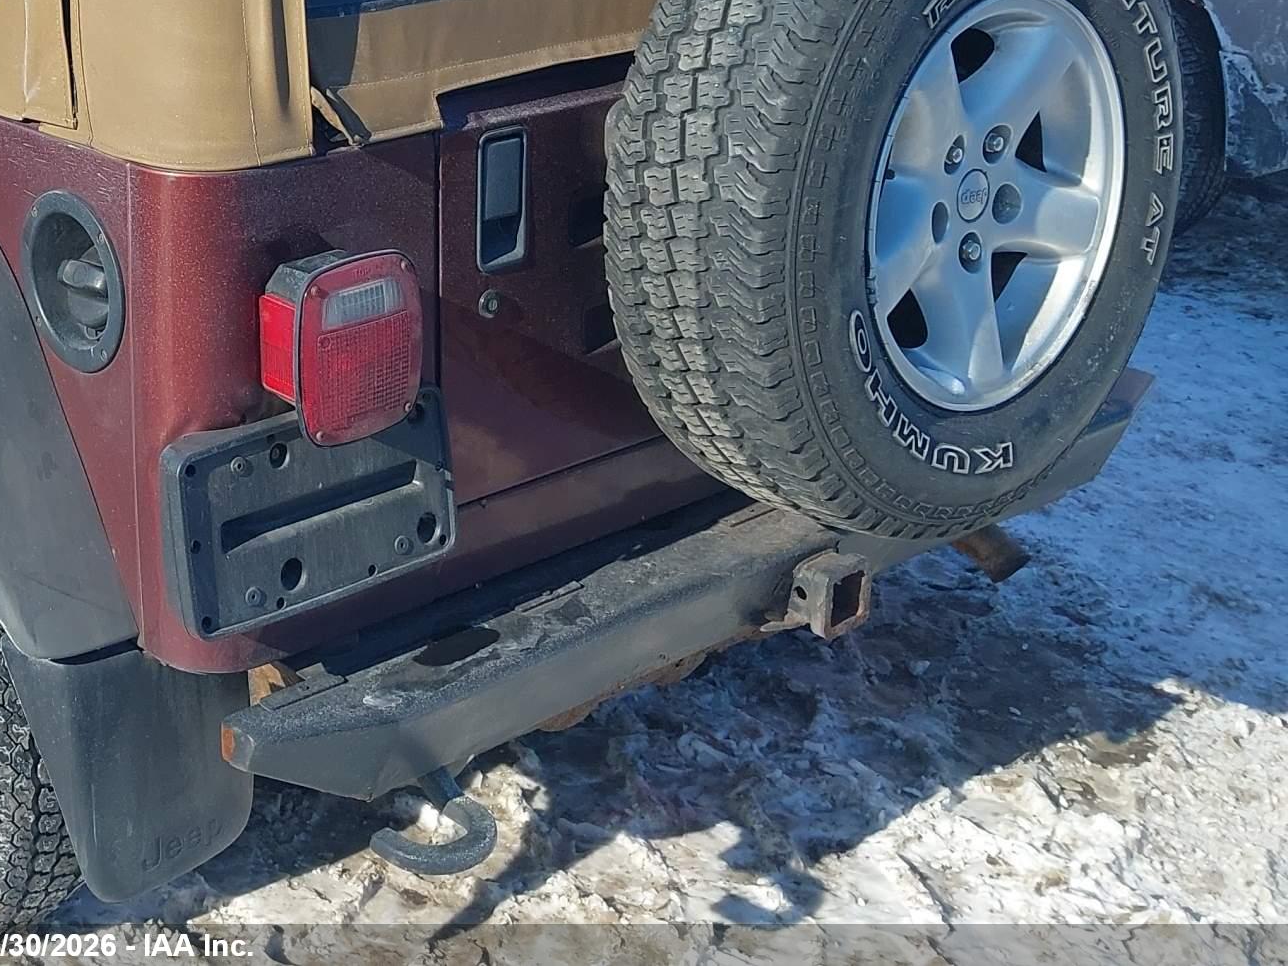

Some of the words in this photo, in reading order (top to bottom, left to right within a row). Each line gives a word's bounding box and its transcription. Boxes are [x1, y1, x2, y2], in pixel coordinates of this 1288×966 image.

[1145, 192, 1164, 266] AT
[849, 309, 1014, 475] KUMHO
[142, 819, 224, 872] Jeep
